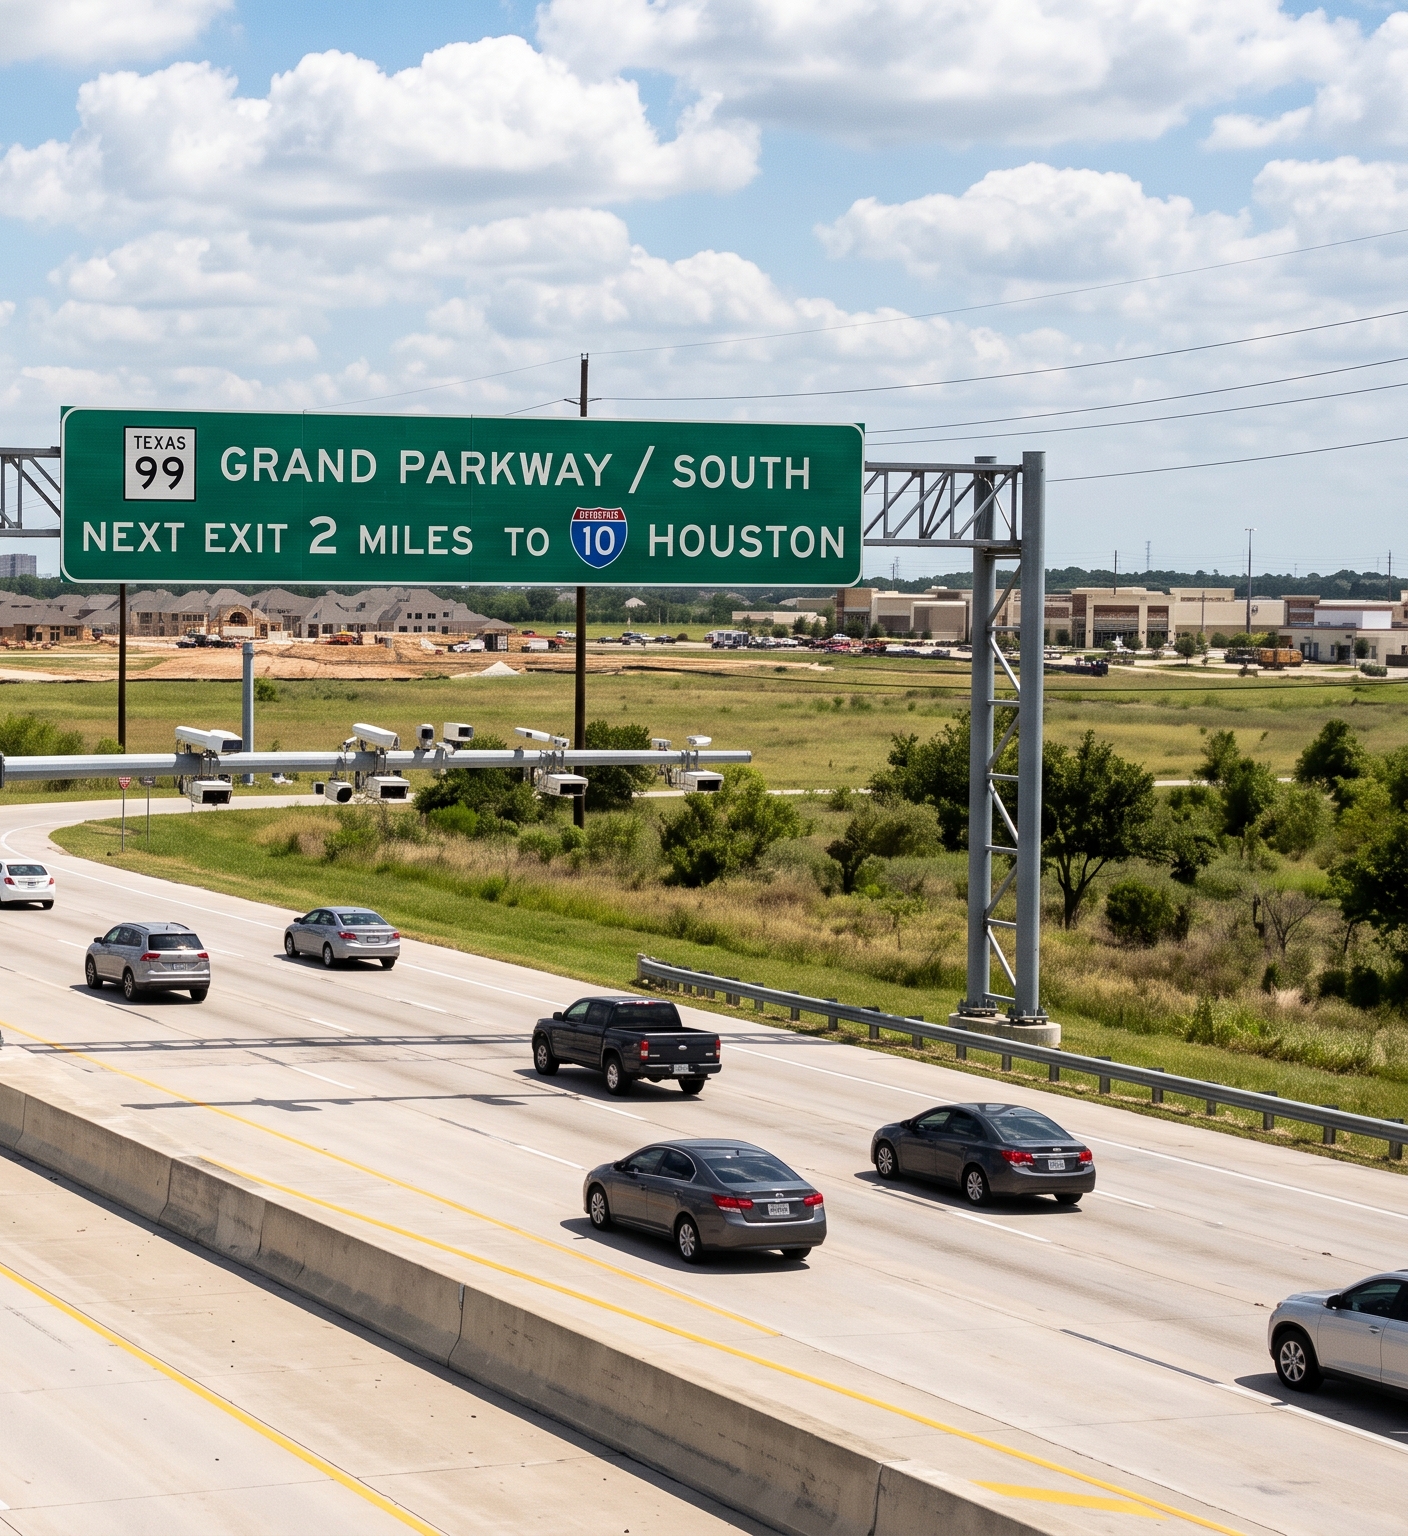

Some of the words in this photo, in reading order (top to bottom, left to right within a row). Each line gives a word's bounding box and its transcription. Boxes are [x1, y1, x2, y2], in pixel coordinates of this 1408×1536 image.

[133, 435, 186, 451] TEXAS
[135, 455, 185, 491] 99
[220, 446, 377, 483] GRAND
[399, 449, 613, 487] PARKWAY
[628, 445, 656, 494] /
[671, 454, 810, 490] SOUTH
[83, 521, 185, 553] NEXT
[204, 522, 288, 554] EXIT
[309, 515, 338, 554] 2
[359, 524, 473, 556] MILES
[504, 527, 550, 557] TO
[582, 525, 616, 556] 10
[649, 523, 845, 559] HOUSTON
